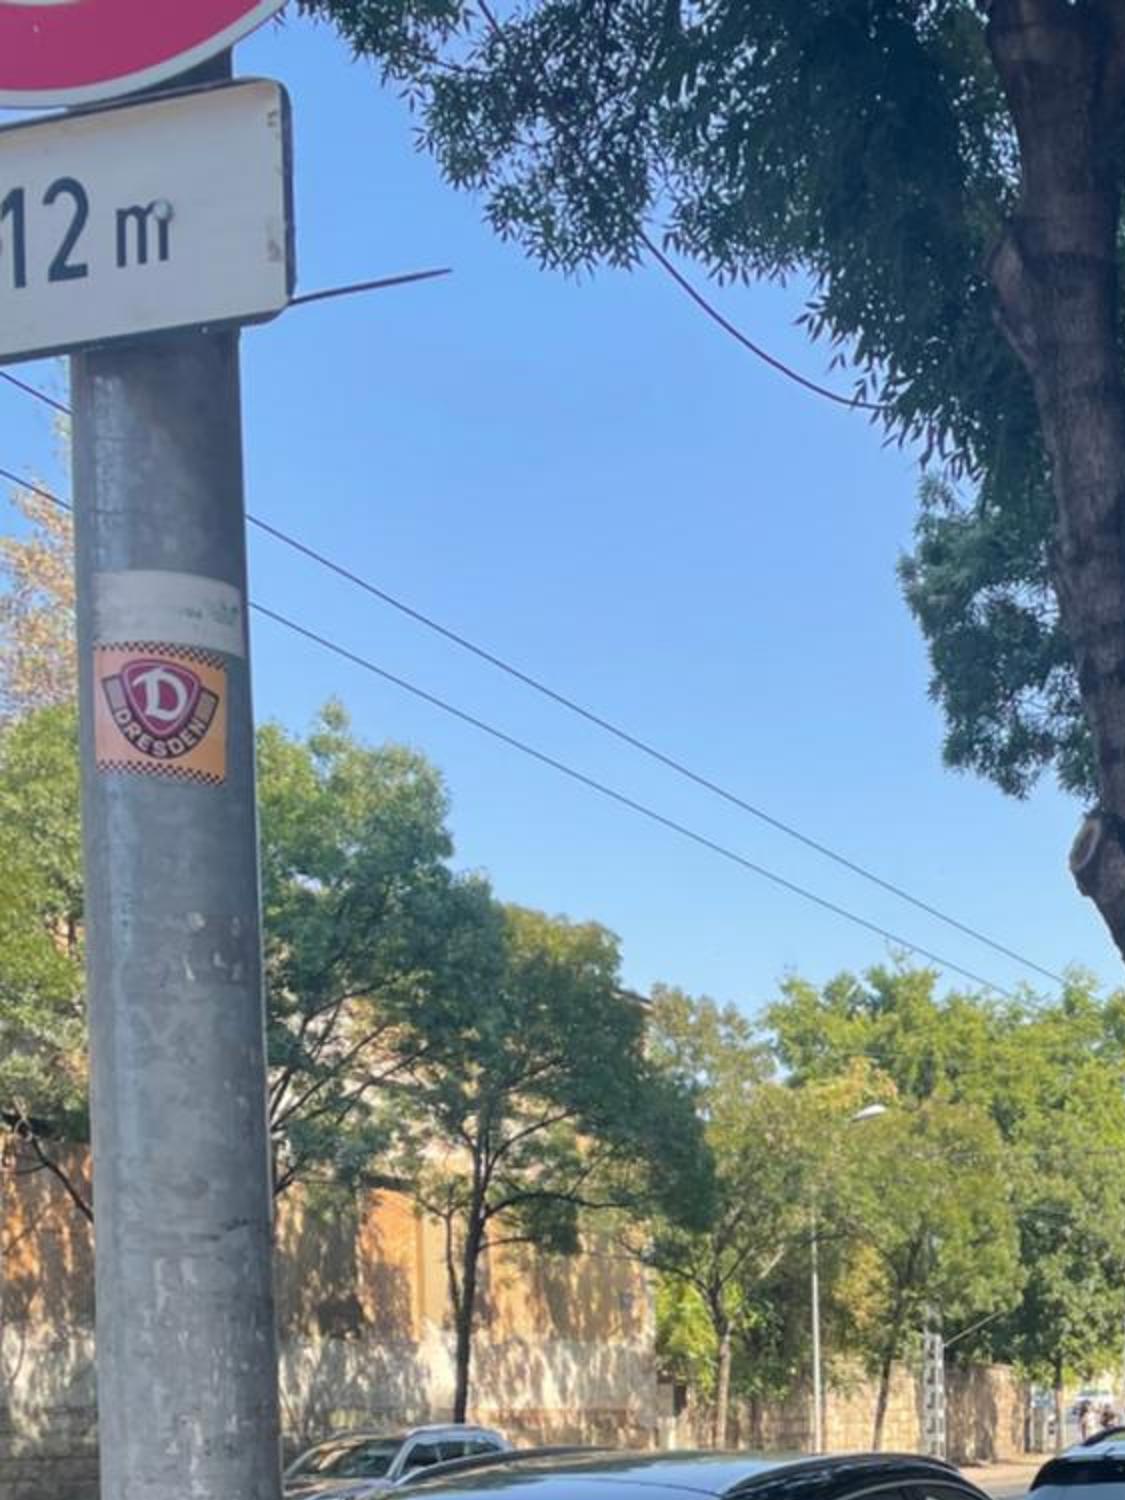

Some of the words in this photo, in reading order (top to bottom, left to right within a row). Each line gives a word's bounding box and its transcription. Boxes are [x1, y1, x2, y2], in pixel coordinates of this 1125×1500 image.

[0, 176, 89, 288] 12
[116, 200, 170, 268] m
[115, 707, 206, 757] DRESDEN
